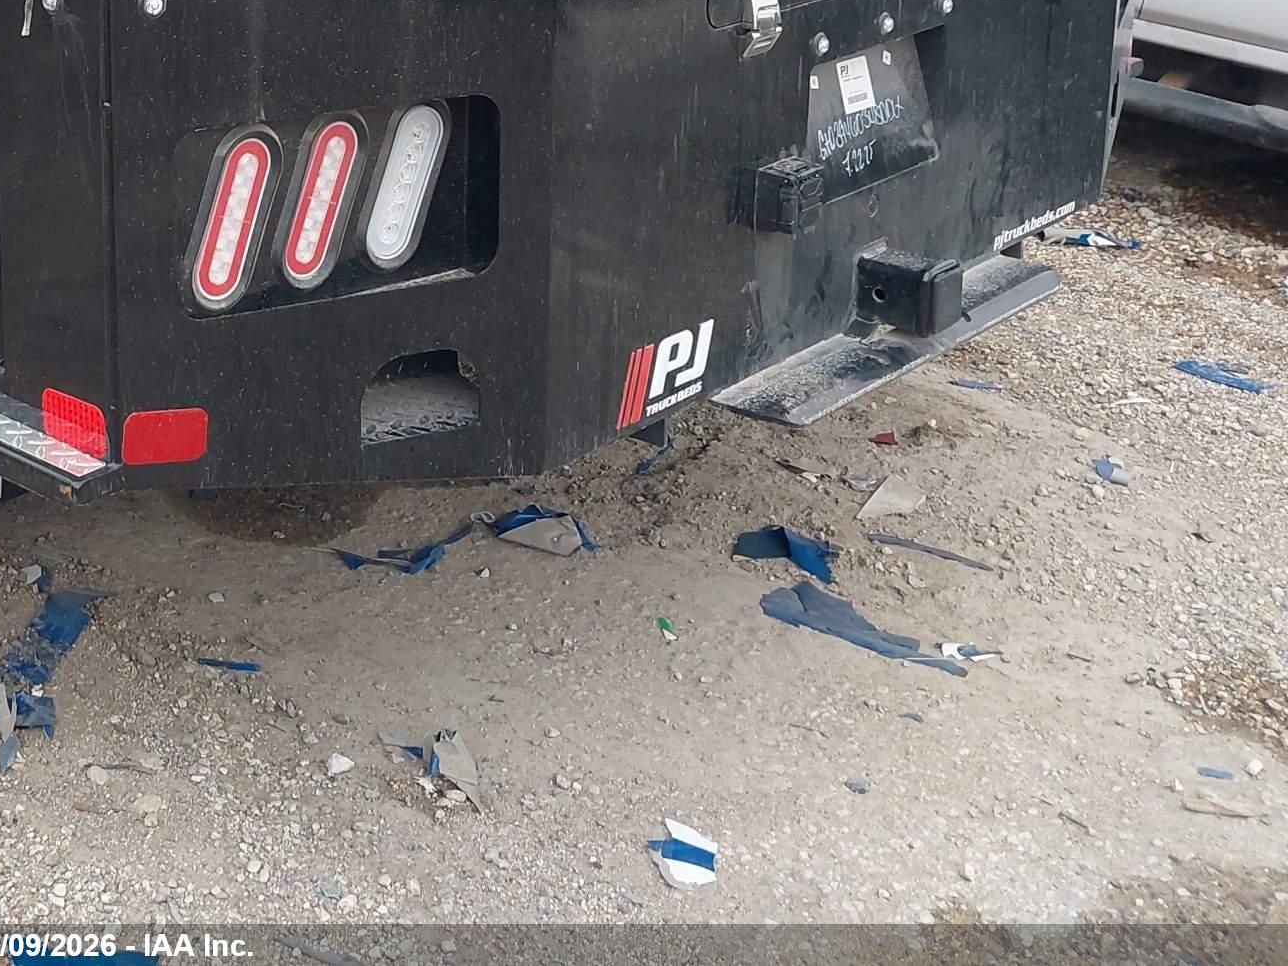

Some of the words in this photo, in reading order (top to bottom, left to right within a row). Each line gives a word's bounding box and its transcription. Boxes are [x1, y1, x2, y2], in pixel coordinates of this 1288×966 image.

[840, 64, 849, 76] PJ
[993, 201, 1076, 251] pjtruckbeds.com
[648, 318, 715, 400] PJ
